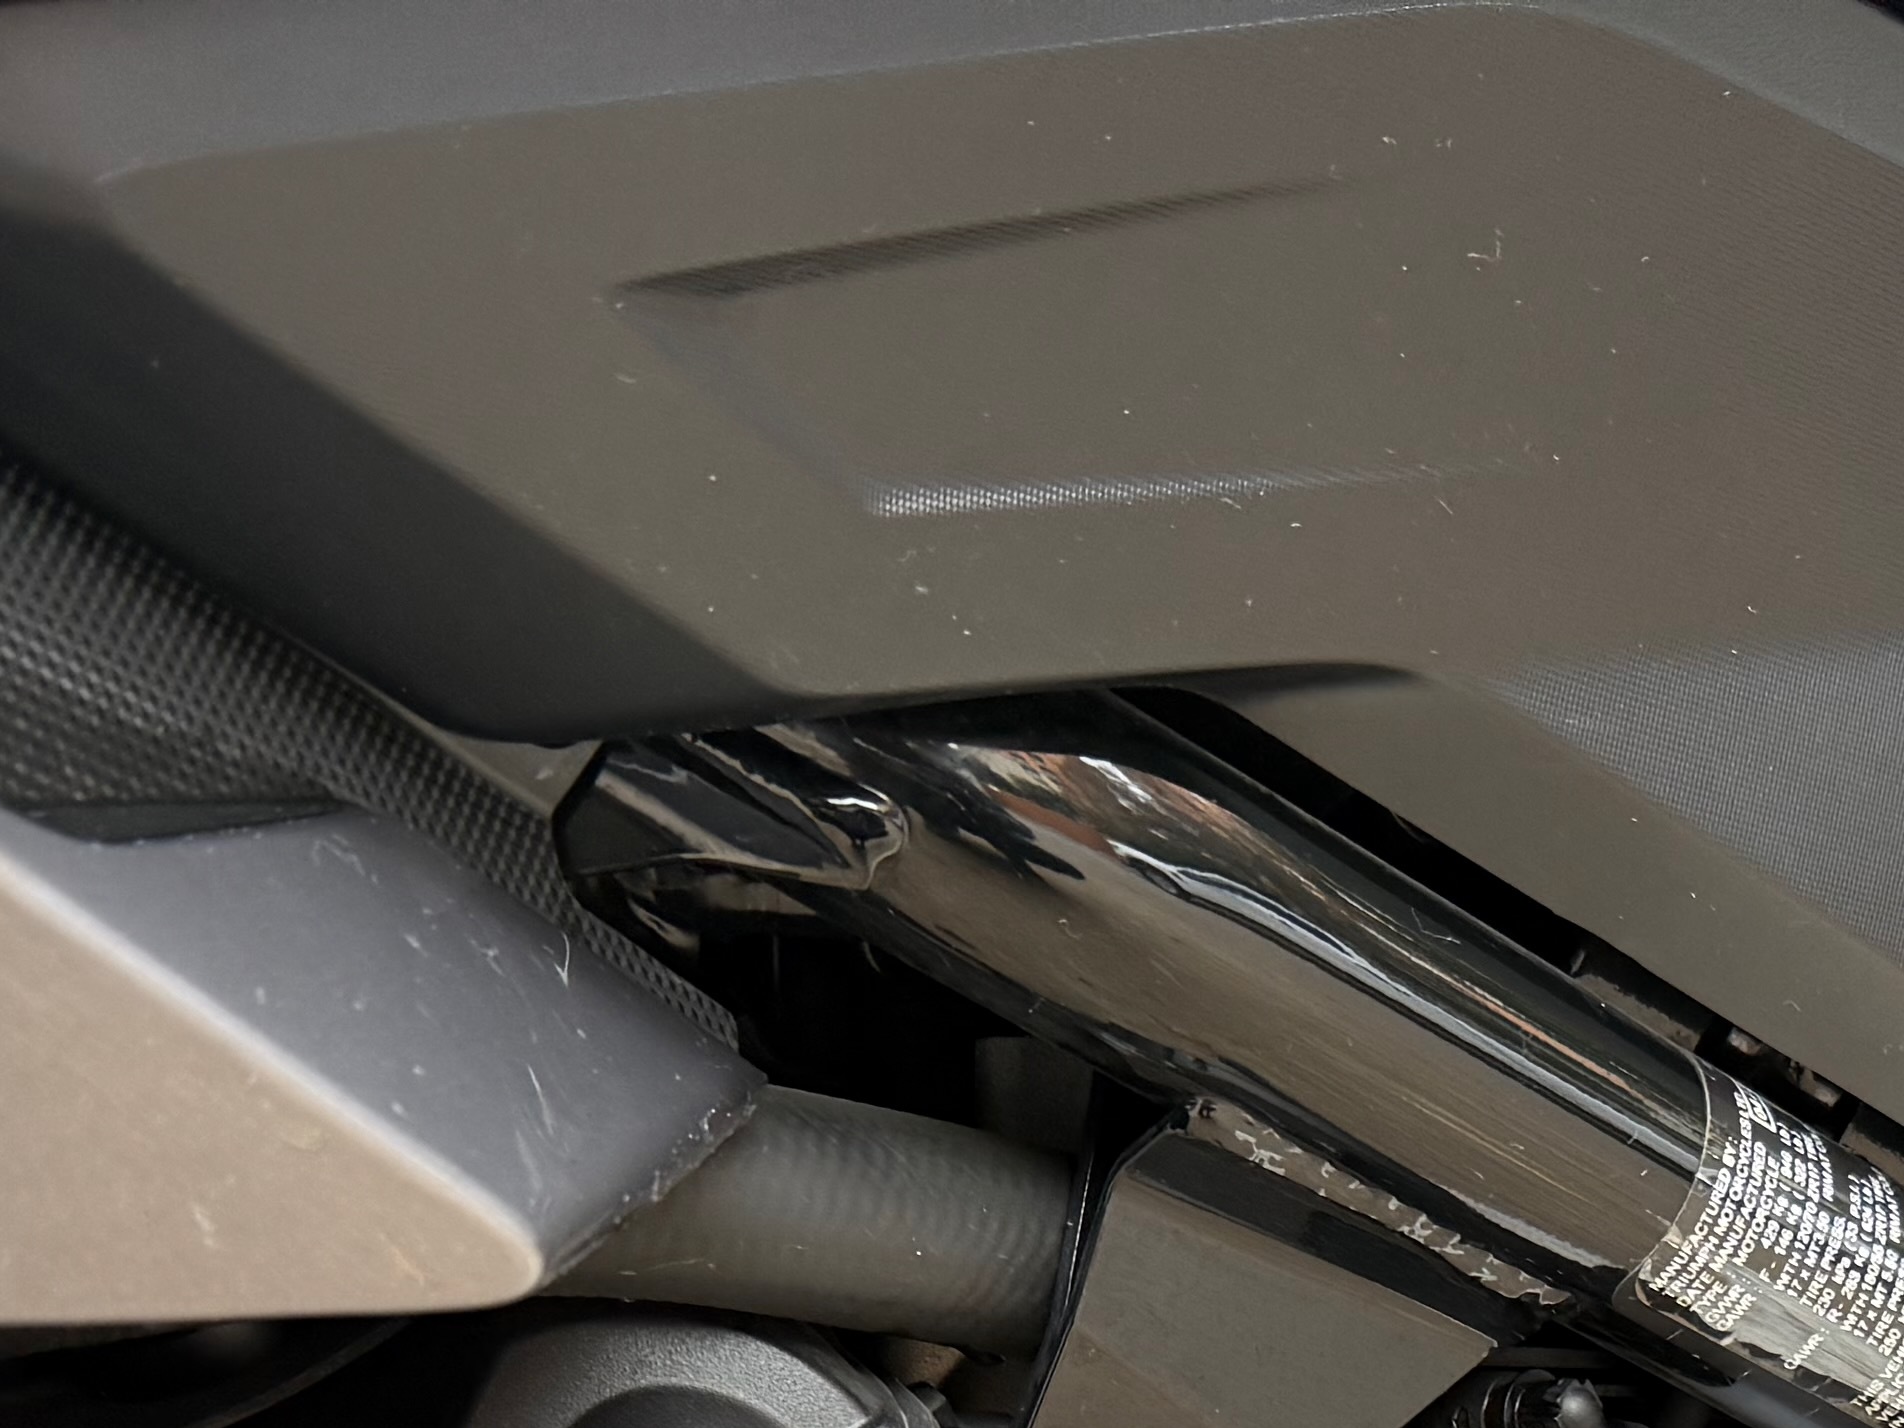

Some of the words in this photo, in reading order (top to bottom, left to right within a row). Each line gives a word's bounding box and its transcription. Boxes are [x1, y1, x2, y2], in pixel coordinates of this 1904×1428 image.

[1661, 1235, 1719, 1297] TRIUMPH
[1713, 1116, 1752, 1236] MOTORCYCLES
[1675, 1270, 1714, 1307] DATE
[1708, 1141, 1766, 1272] MANUFACTURED
[1648, 1167, 1731, 1291] MANUFACTURED
[1689, 1280, 1727, 1316] TYPE
[1731, 1155, 1779, 1267] MOTORCYCLE
[1772, 1251, 1802, 1291] WITH
[1786, 1278, 1802, 1297] 17
[1798, 1269, 1828, 1309] TIRE
[1811, 1287, 1835, 1317] 230
[1838, 1292, 1869, 1331] WITH
[1852, 1319, 1868, 1337] 17
[1865, 1310, 1894, 1346] TIRE
[1849, 1378, 1885, 1406] THIS
